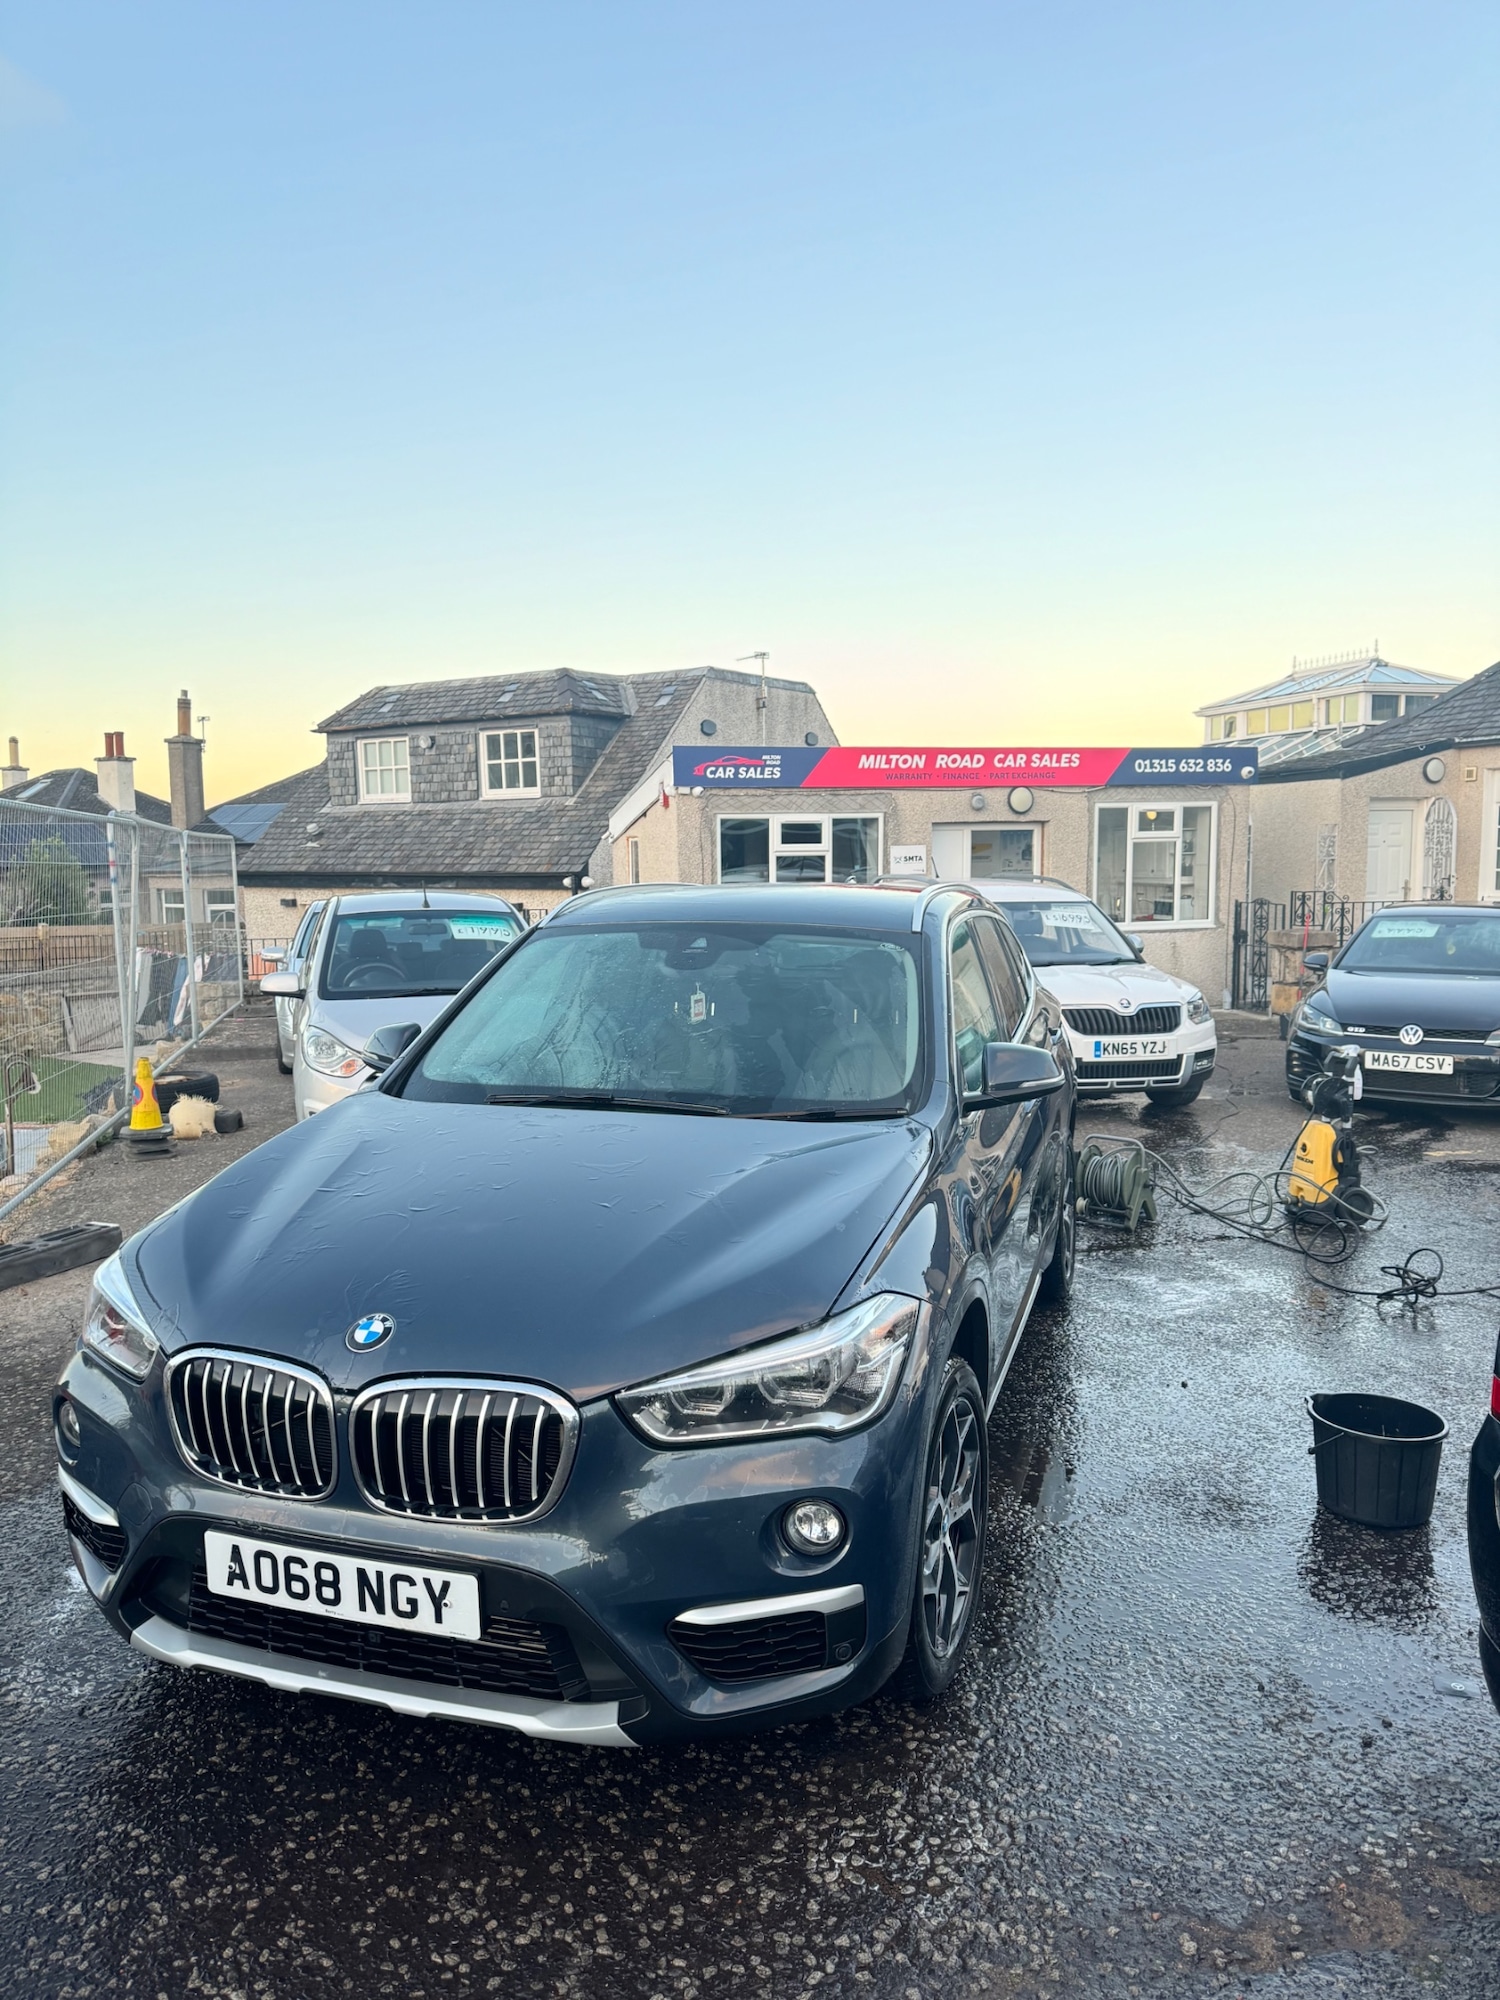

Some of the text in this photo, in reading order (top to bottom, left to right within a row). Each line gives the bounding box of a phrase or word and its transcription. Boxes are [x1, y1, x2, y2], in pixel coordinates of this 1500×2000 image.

[858, 753, 1080, 769] MILTON ROAD CAR SALES
[1134, 759, 1232, 772] 01315 632 836
[706, 767, 781, 778] CAR SALES
[943, 772, 980, 780] FINANCE
[990, 772, 1009, 780] PART
[1102, 1042, 1137, 1055] KN65
[1141, 1041, 1166, 1054] YZJ
[1372, 1053, 1446, 1070] MA67 CSV
[226, 1544, 451, 1624] AO68 NGY
